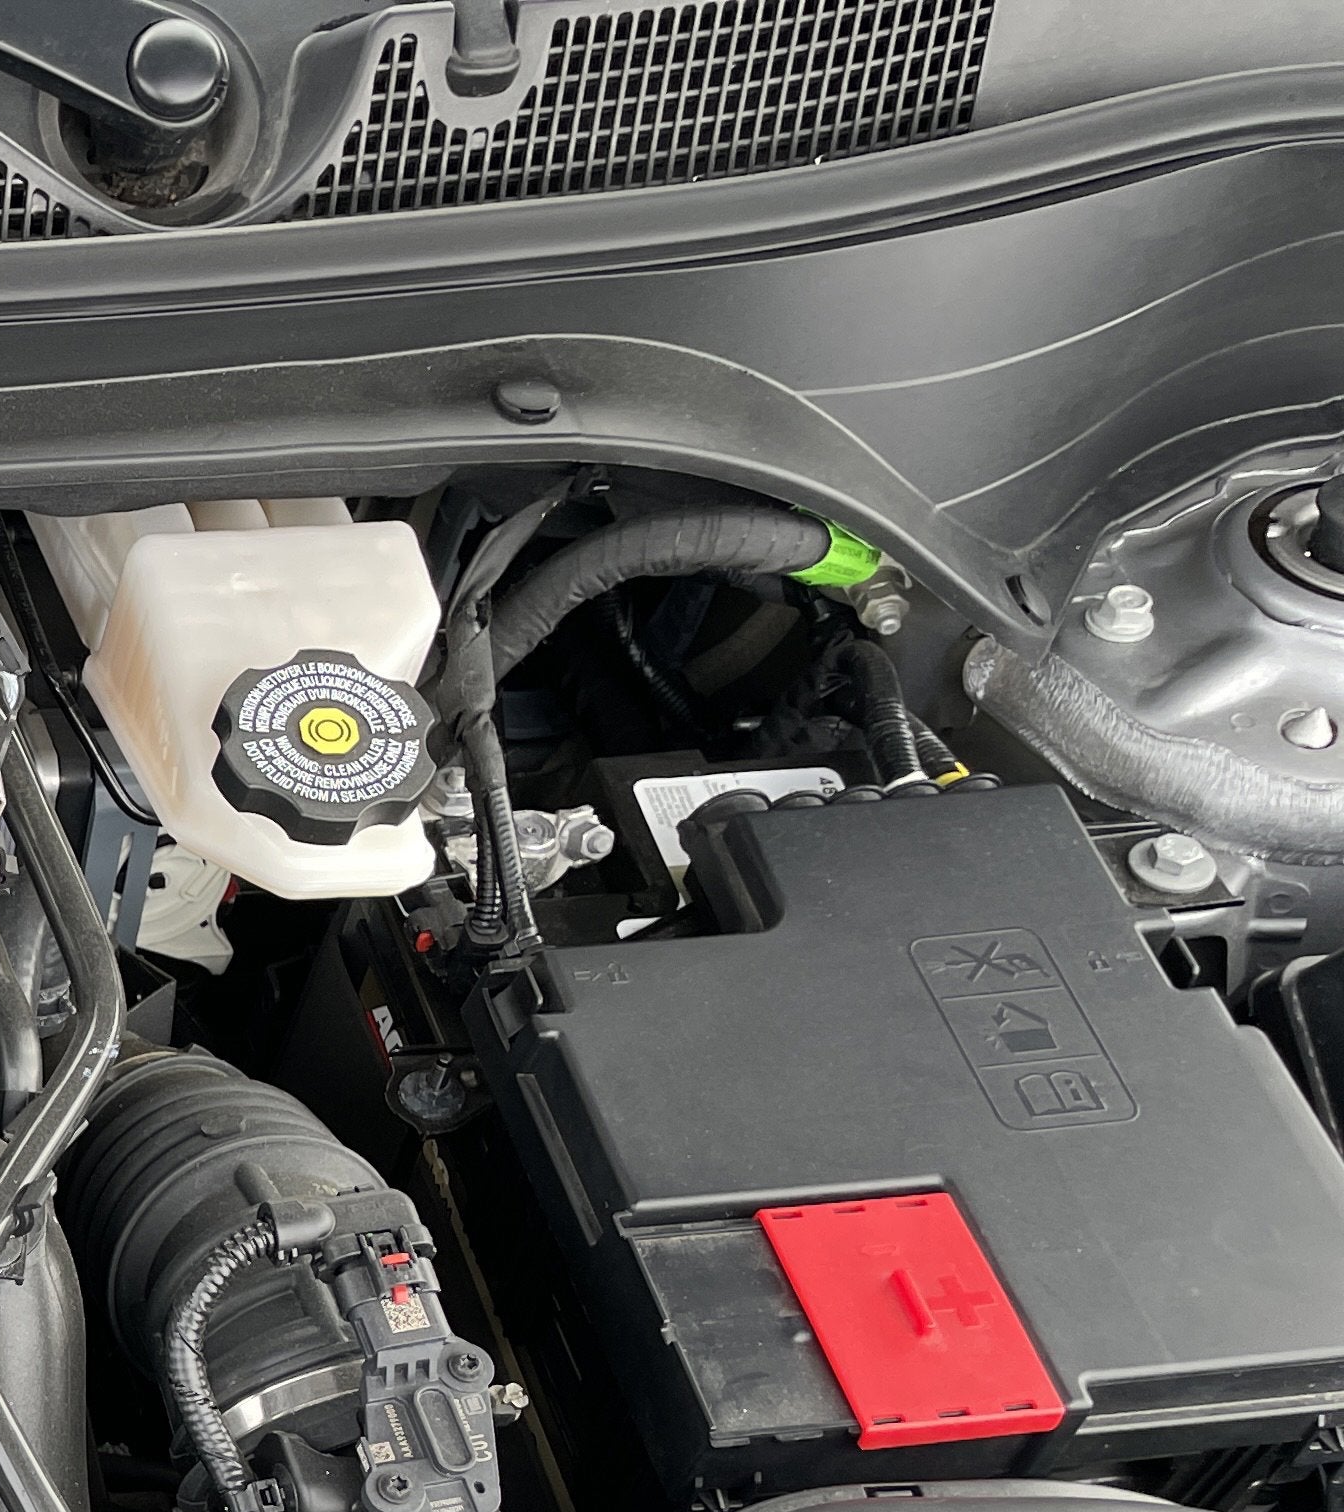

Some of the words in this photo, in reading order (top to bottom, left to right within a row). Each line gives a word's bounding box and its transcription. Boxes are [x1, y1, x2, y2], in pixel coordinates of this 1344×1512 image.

[317, 662, 366, 682] BOUCHON
[363, 675, 396, 699] AVANT
[258, 738, 281, 758] CAP
[272, 755, 316, 786] BEFORE
[382, 738, 403, 764] ONLY
[323, 760, 364, 777] CLEAN
[358, 737, 387, 769] FILLER
[260, 764, 295, 790] FLUID
[292, 782, 330, 802] FROM
[329, 789, 340, 803] A
[339, 781, 385, 804] SEALED
